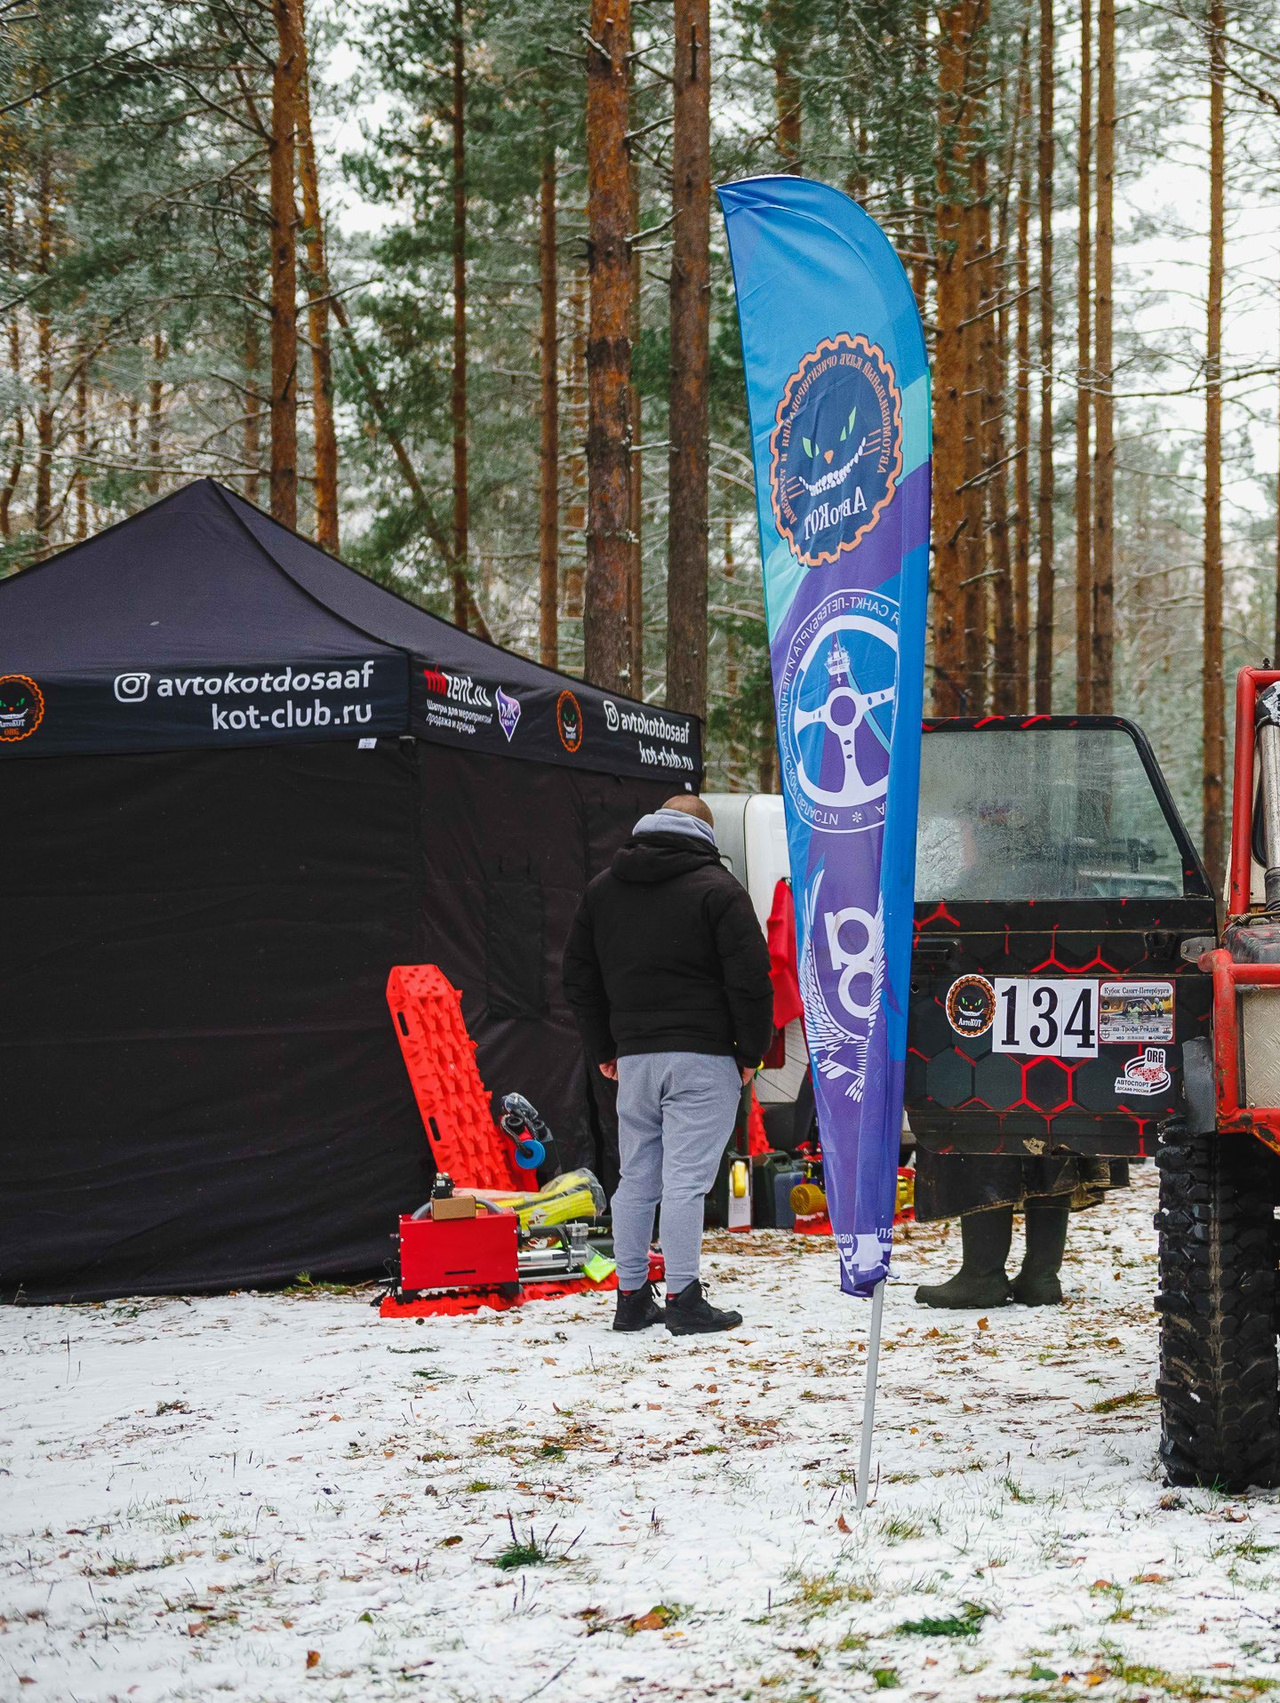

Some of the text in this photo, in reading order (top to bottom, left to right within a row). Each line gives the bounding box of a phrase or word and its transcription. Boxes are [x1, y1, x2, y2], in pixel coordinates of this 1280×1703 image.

[157, 660, 375, 697] avtokotdosaaf
[211, 699, 372, 730] kot-club.ru
[426, 698, 448, 715] Шатры
[426, 712, 452, 728] продажа
[620, 712, 690, 744] avtokotdosaaf
[638, 740, 694, 771] kot-club.ru
[1001, 985, 1096, 1048] 134
[1147, 1049, 1164, 1064] ORG
[1116, 1079, 1150, 1088] АВТОСПОРТ
